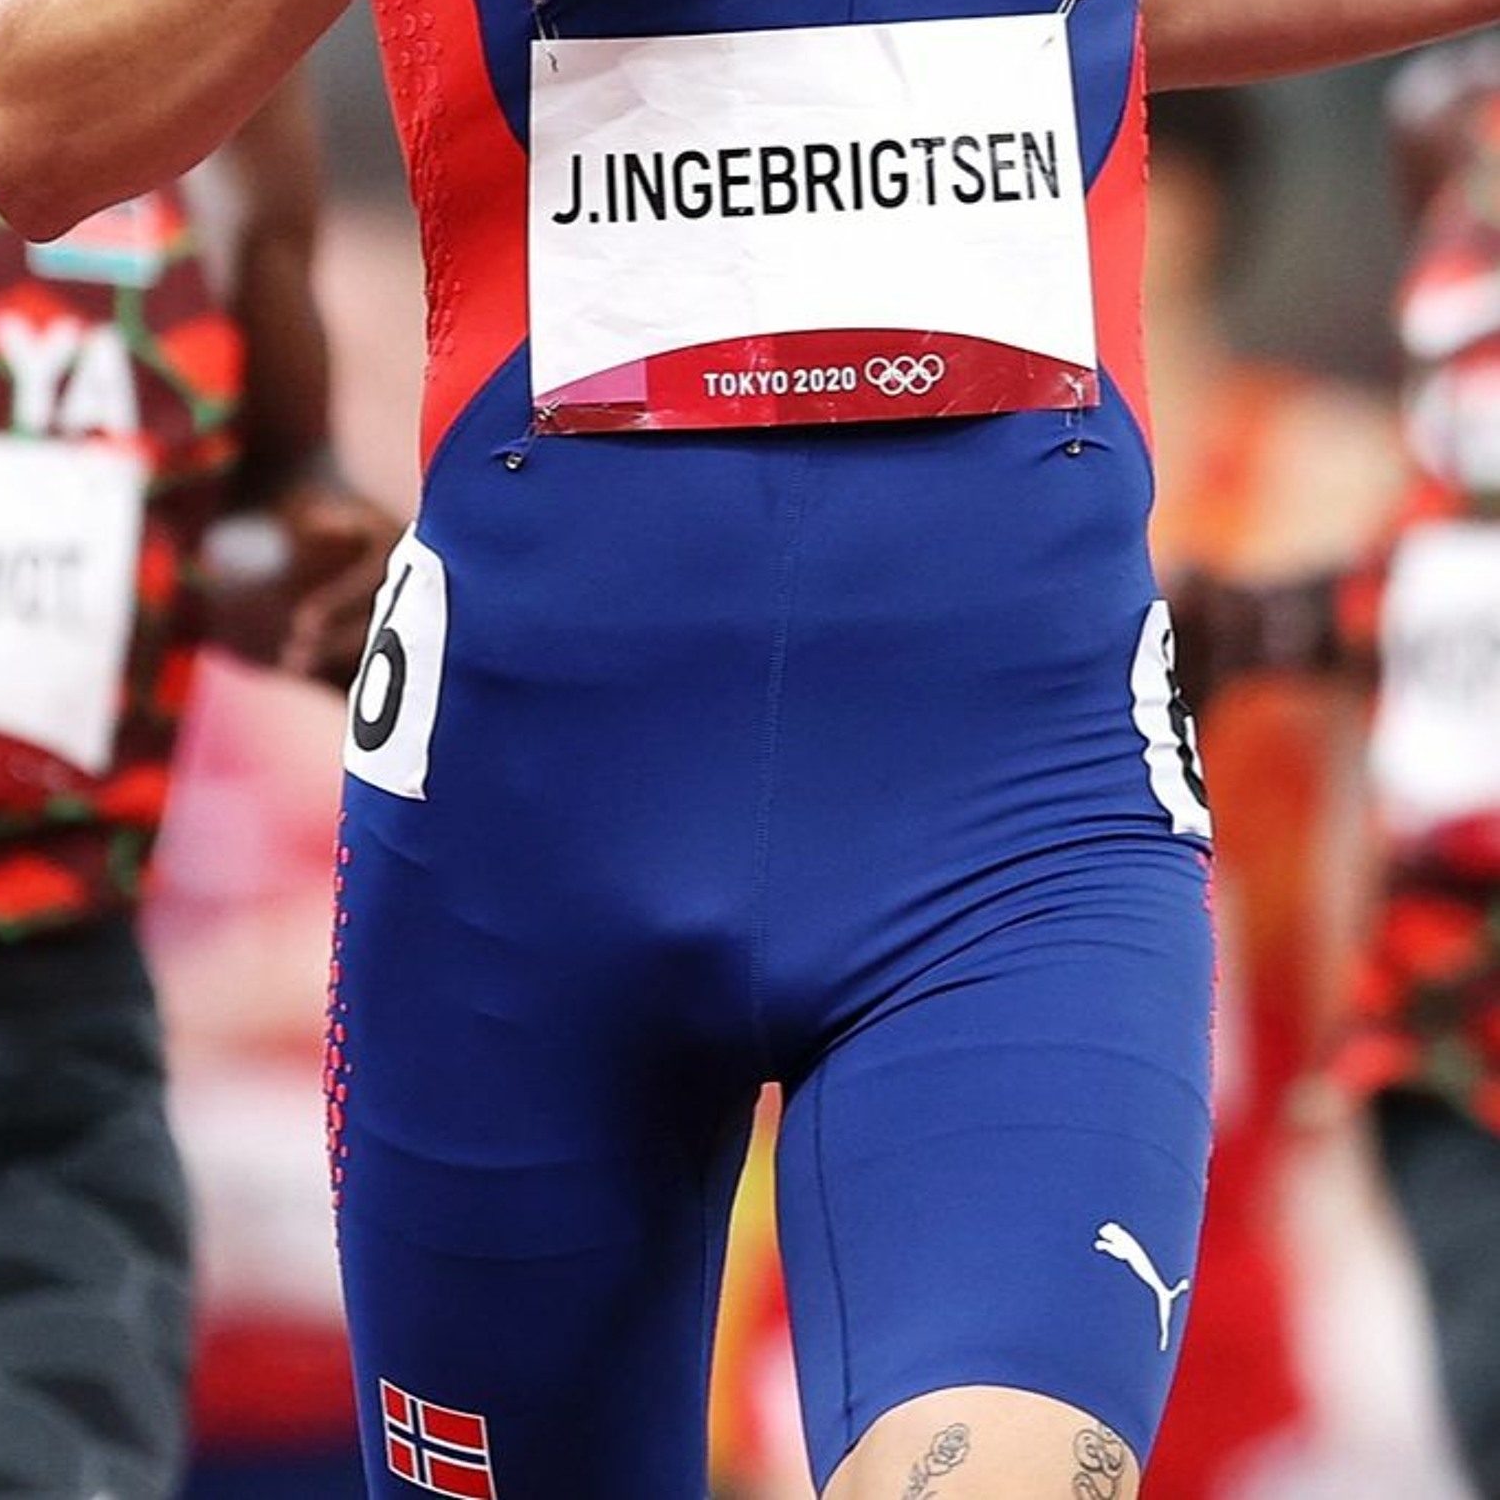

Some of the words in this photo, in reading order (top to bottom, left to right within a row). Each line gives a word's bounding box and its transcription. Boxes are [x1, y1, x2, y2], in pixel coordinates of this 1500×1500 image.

[552, 130, 1060, 226] J.INGEBRIGTSEN
[703, 371, 789, 397] TOKYO
[794, 366, 858, 393] 2020
[352, 562, 413, 752] 6
